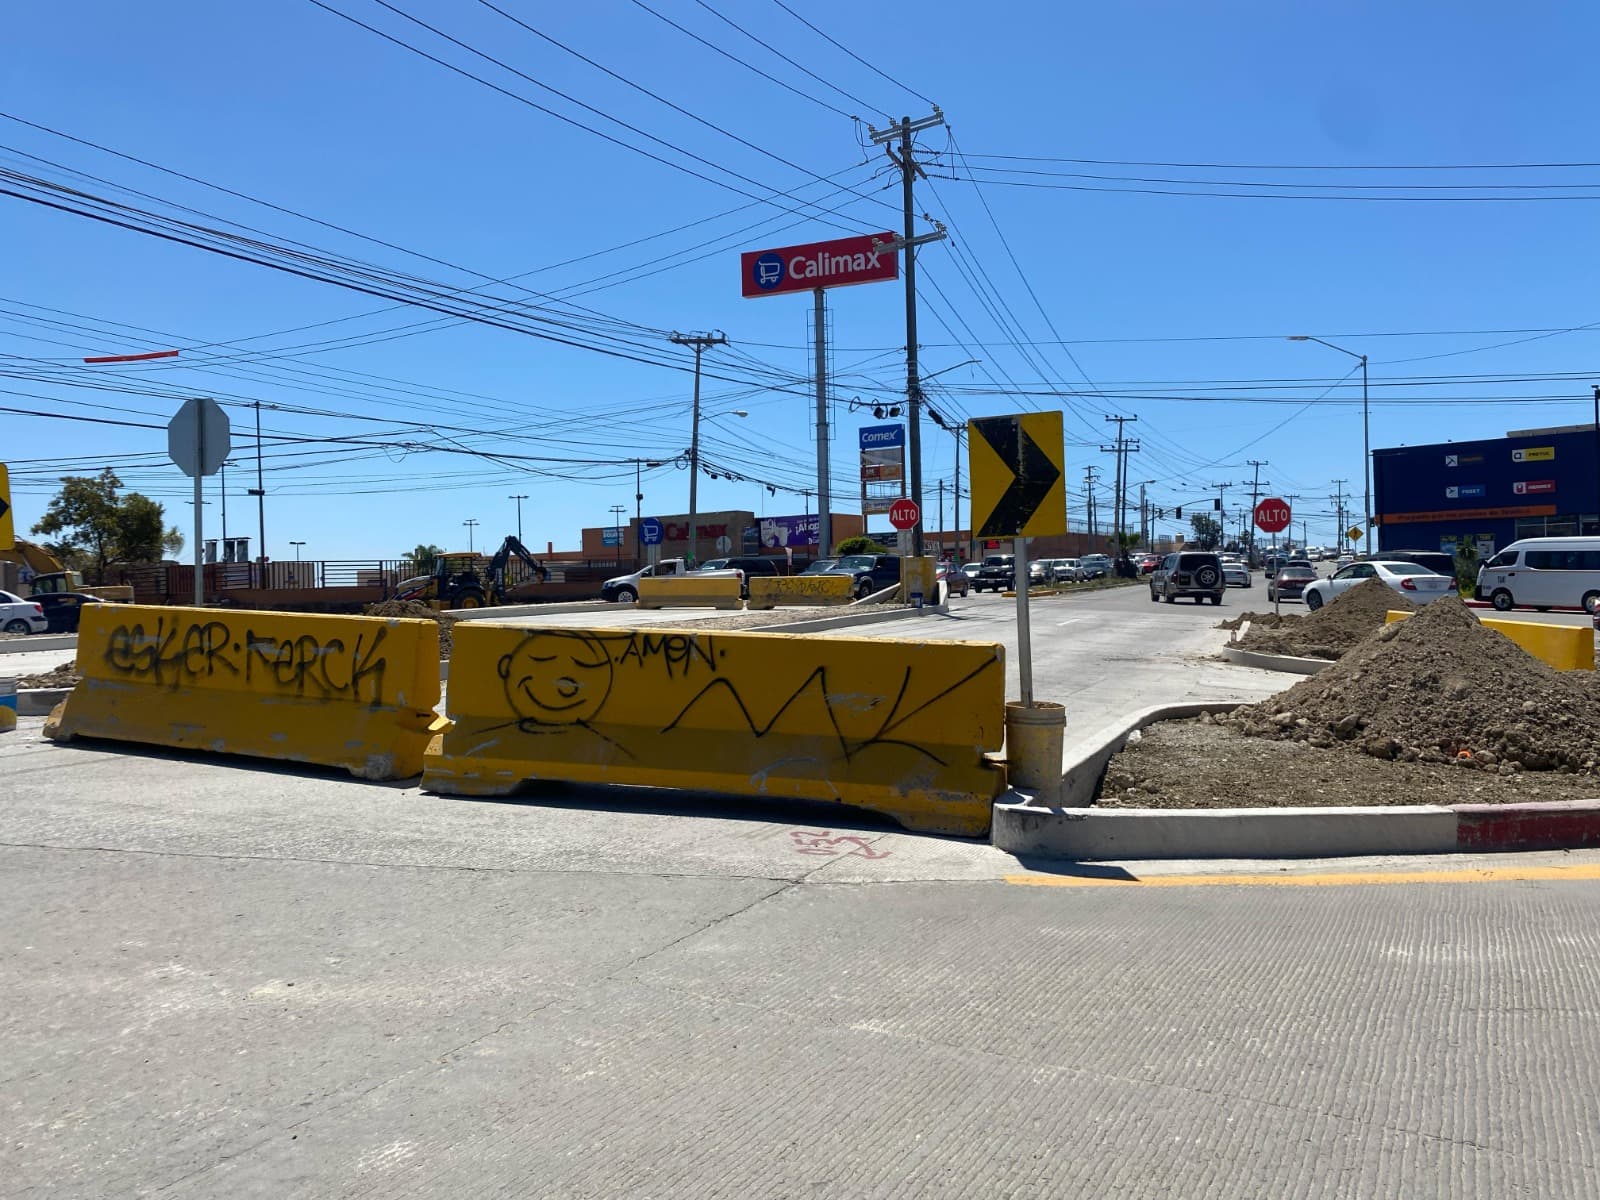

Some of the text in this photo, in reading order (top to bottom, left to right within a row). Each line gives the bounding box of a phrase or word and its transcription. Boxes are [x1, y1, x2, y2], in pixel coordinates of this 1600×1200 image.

[789, 251, 881, 279] Calimax
[861, 429, 898, 442] Comex
[891, 509, 917, 521] ALTO
[1258, 508, 1288, 522] ALTO
